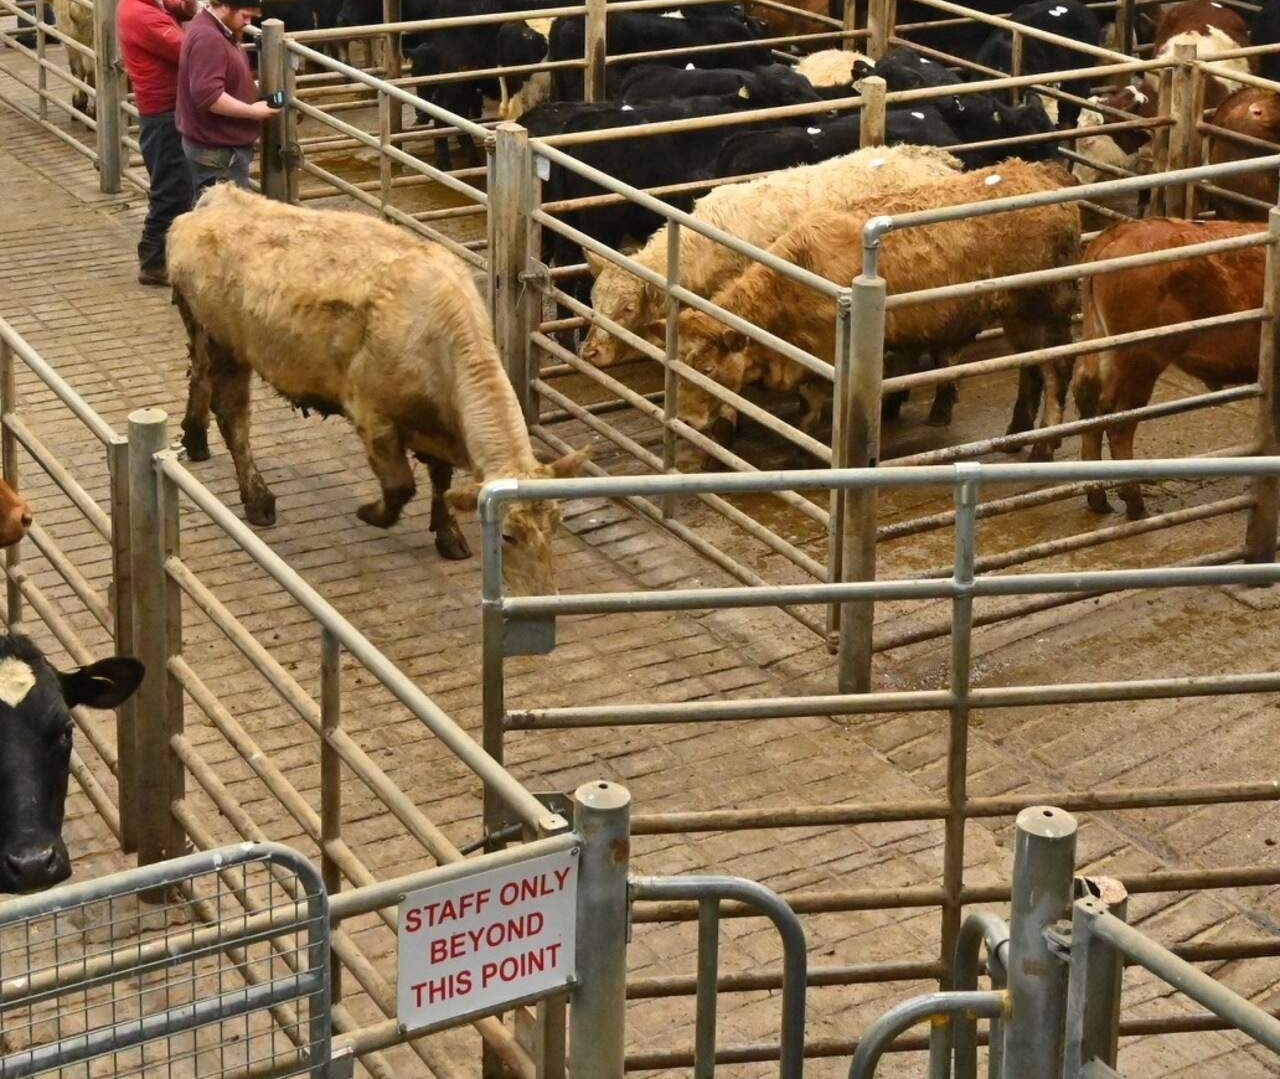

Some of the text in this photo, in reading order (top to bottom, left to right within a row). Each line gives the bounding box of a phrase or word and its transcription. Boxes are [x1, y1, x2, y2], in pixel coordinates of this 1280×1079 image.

[405, 867, 570, 933] STAFF ONLY
[430, 912, 544, 964] BEYOND
[410, 943, 562, 1008] THIS POINT
